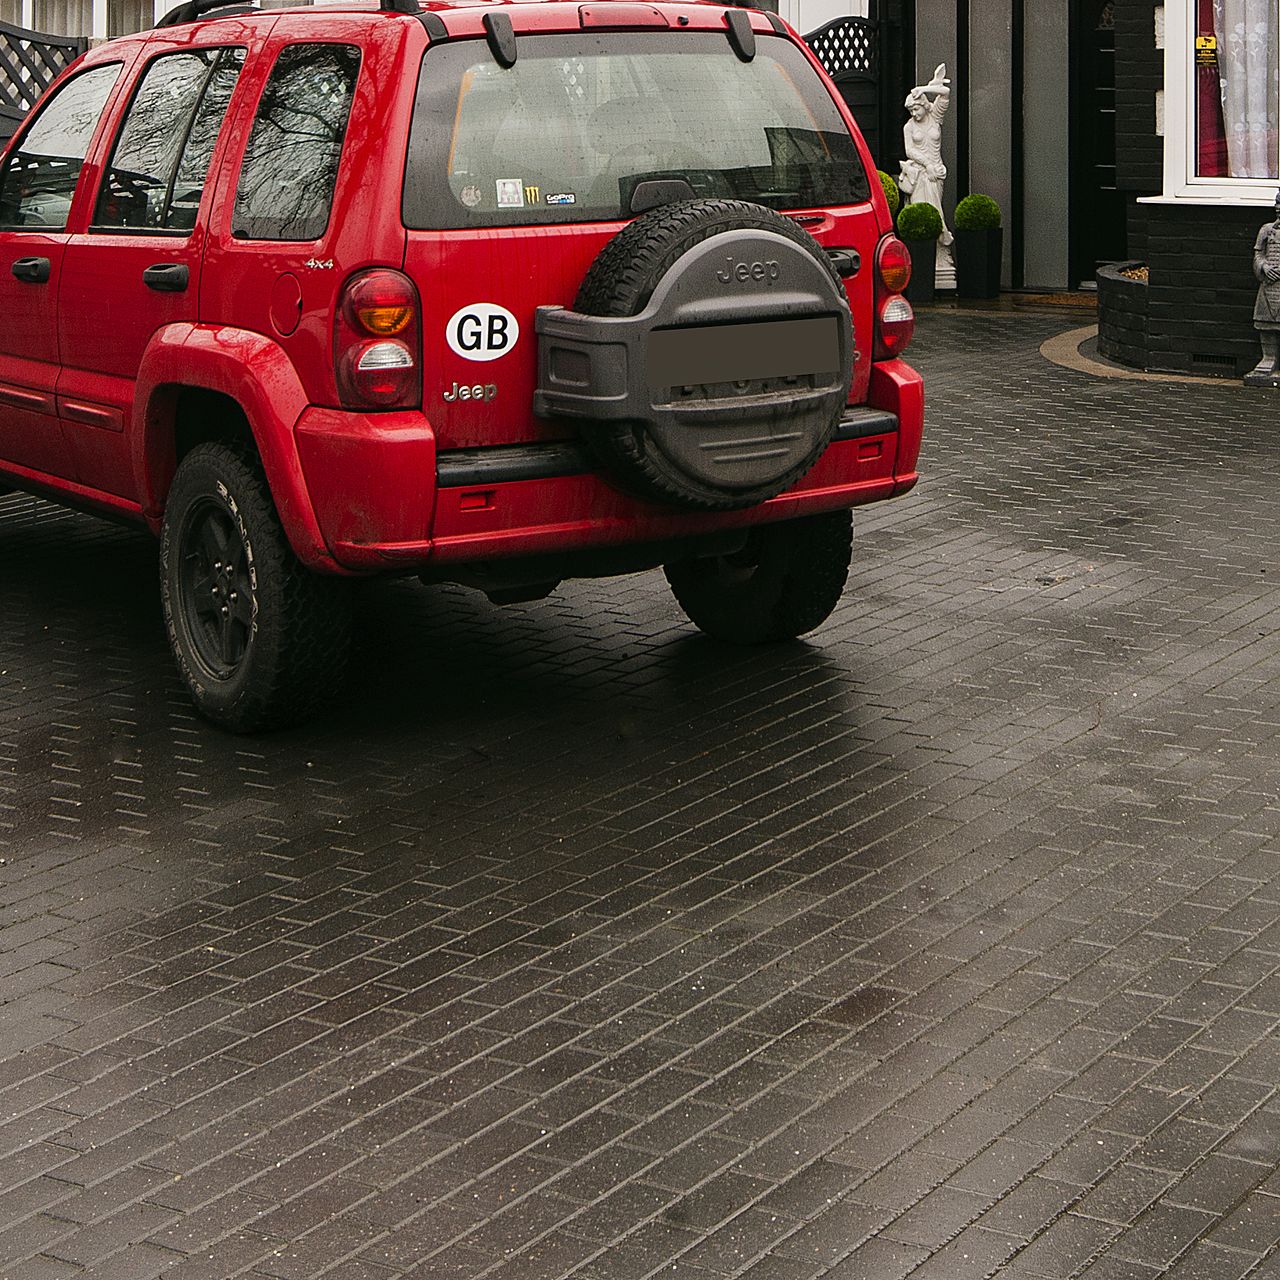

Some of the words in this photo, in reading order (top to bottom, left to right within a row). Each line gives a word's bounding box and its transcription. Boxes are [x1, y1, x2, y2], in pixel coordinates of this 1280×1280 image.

[546, 193, 575, 201] GoPro
[717, 256, 780, 286] Jeep
[457, 314, 509, 351] GB
[443, 382, 497, 403] Jeep
